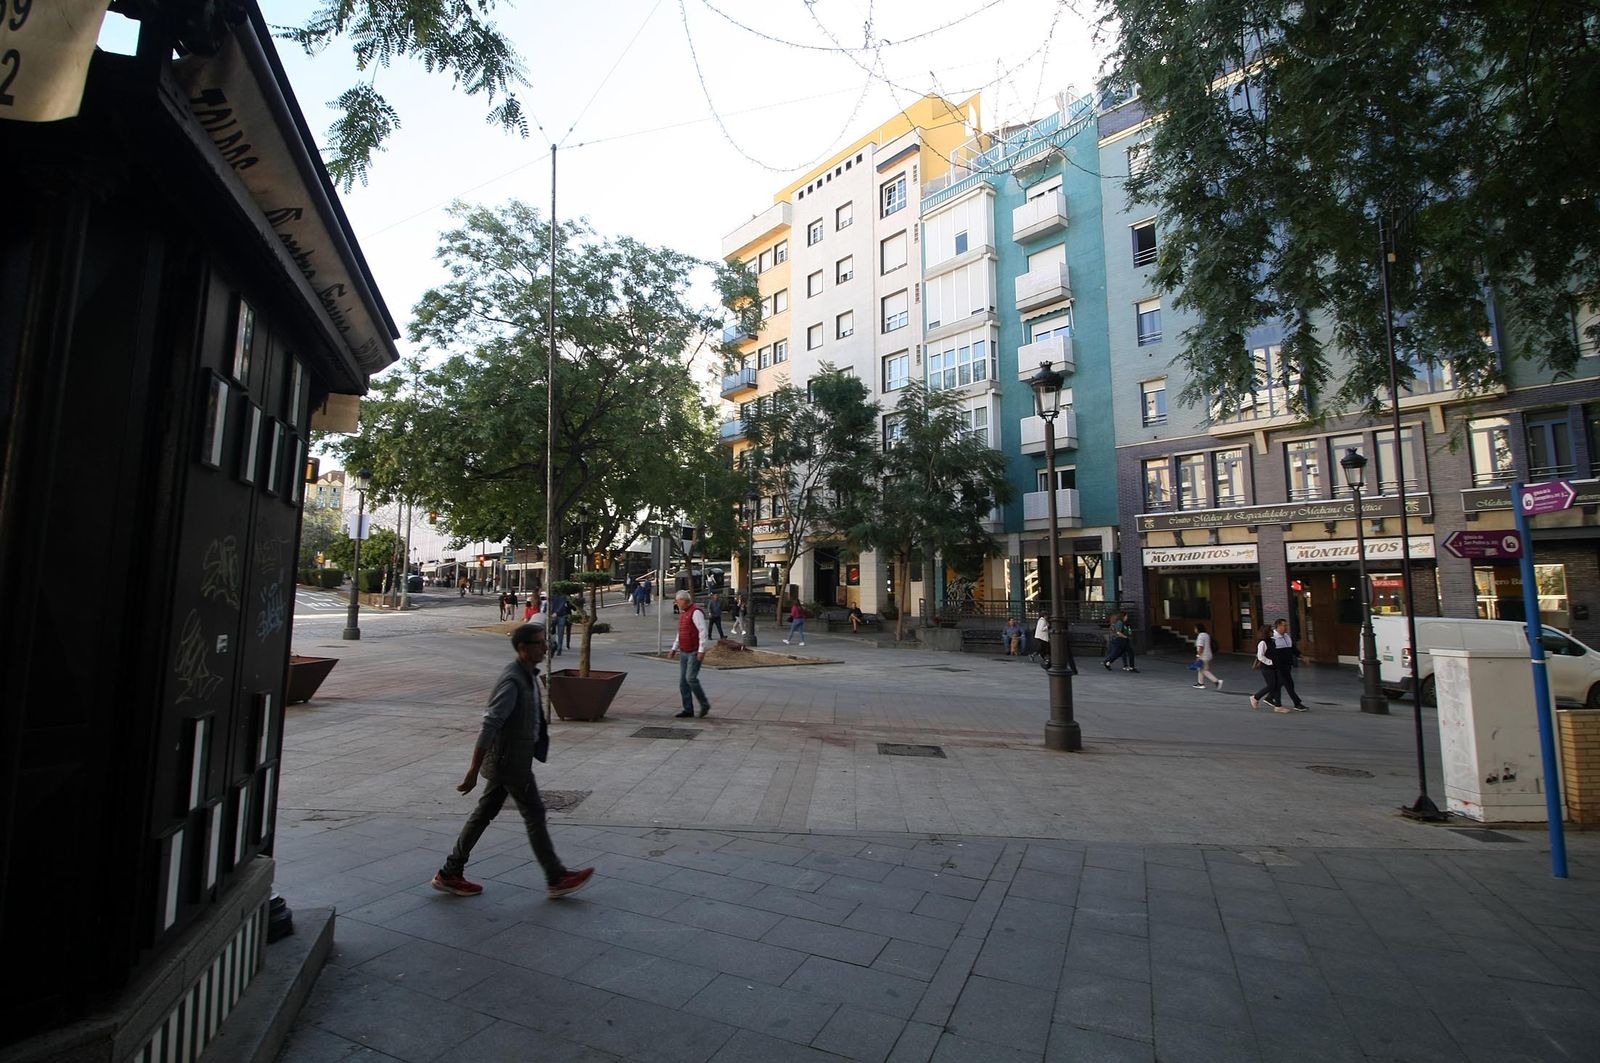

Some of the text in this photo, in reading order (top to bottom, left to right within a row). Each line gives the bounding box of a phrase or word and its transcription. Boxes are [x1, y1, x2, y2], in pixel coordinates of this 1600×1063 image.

[1169, 516, 1191, 525] Centro
[1192, 513, 1223, 523] Médico
[1223, 512, 1233, 521] de
[1234, 508, 1289, 521] Especialidades
[1289, 510, 1297, 520] y
[1298, 506, 1342, 516] Medicina
[504, 547, 512, 555] P
[1151, 549, 1230, 563] MONTADITOS
